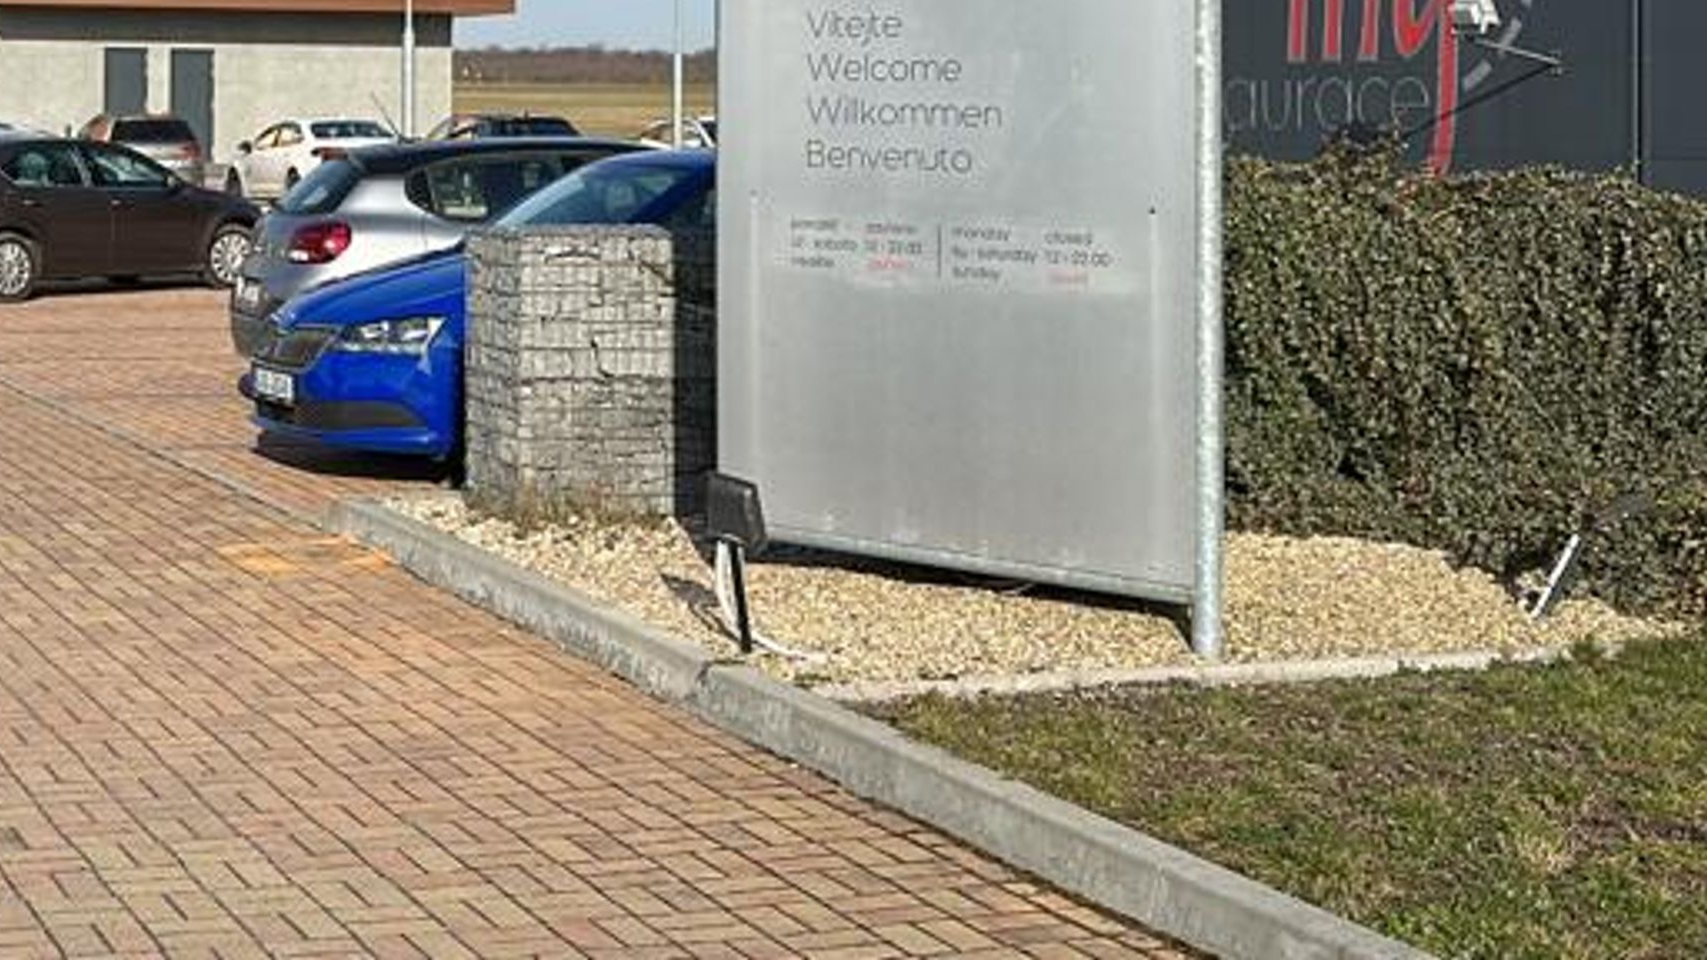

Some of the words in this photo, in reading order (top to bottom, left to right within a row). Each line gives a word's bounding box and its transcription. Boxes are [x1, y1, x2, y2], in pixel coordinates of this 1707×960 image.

[806, 52, 963, 83] Welcome
[806, 95, 1003, 129] Willkommen
[1224, 75, 1430, 132] aurace
[806, 138, 974, 175] Benvenuto
